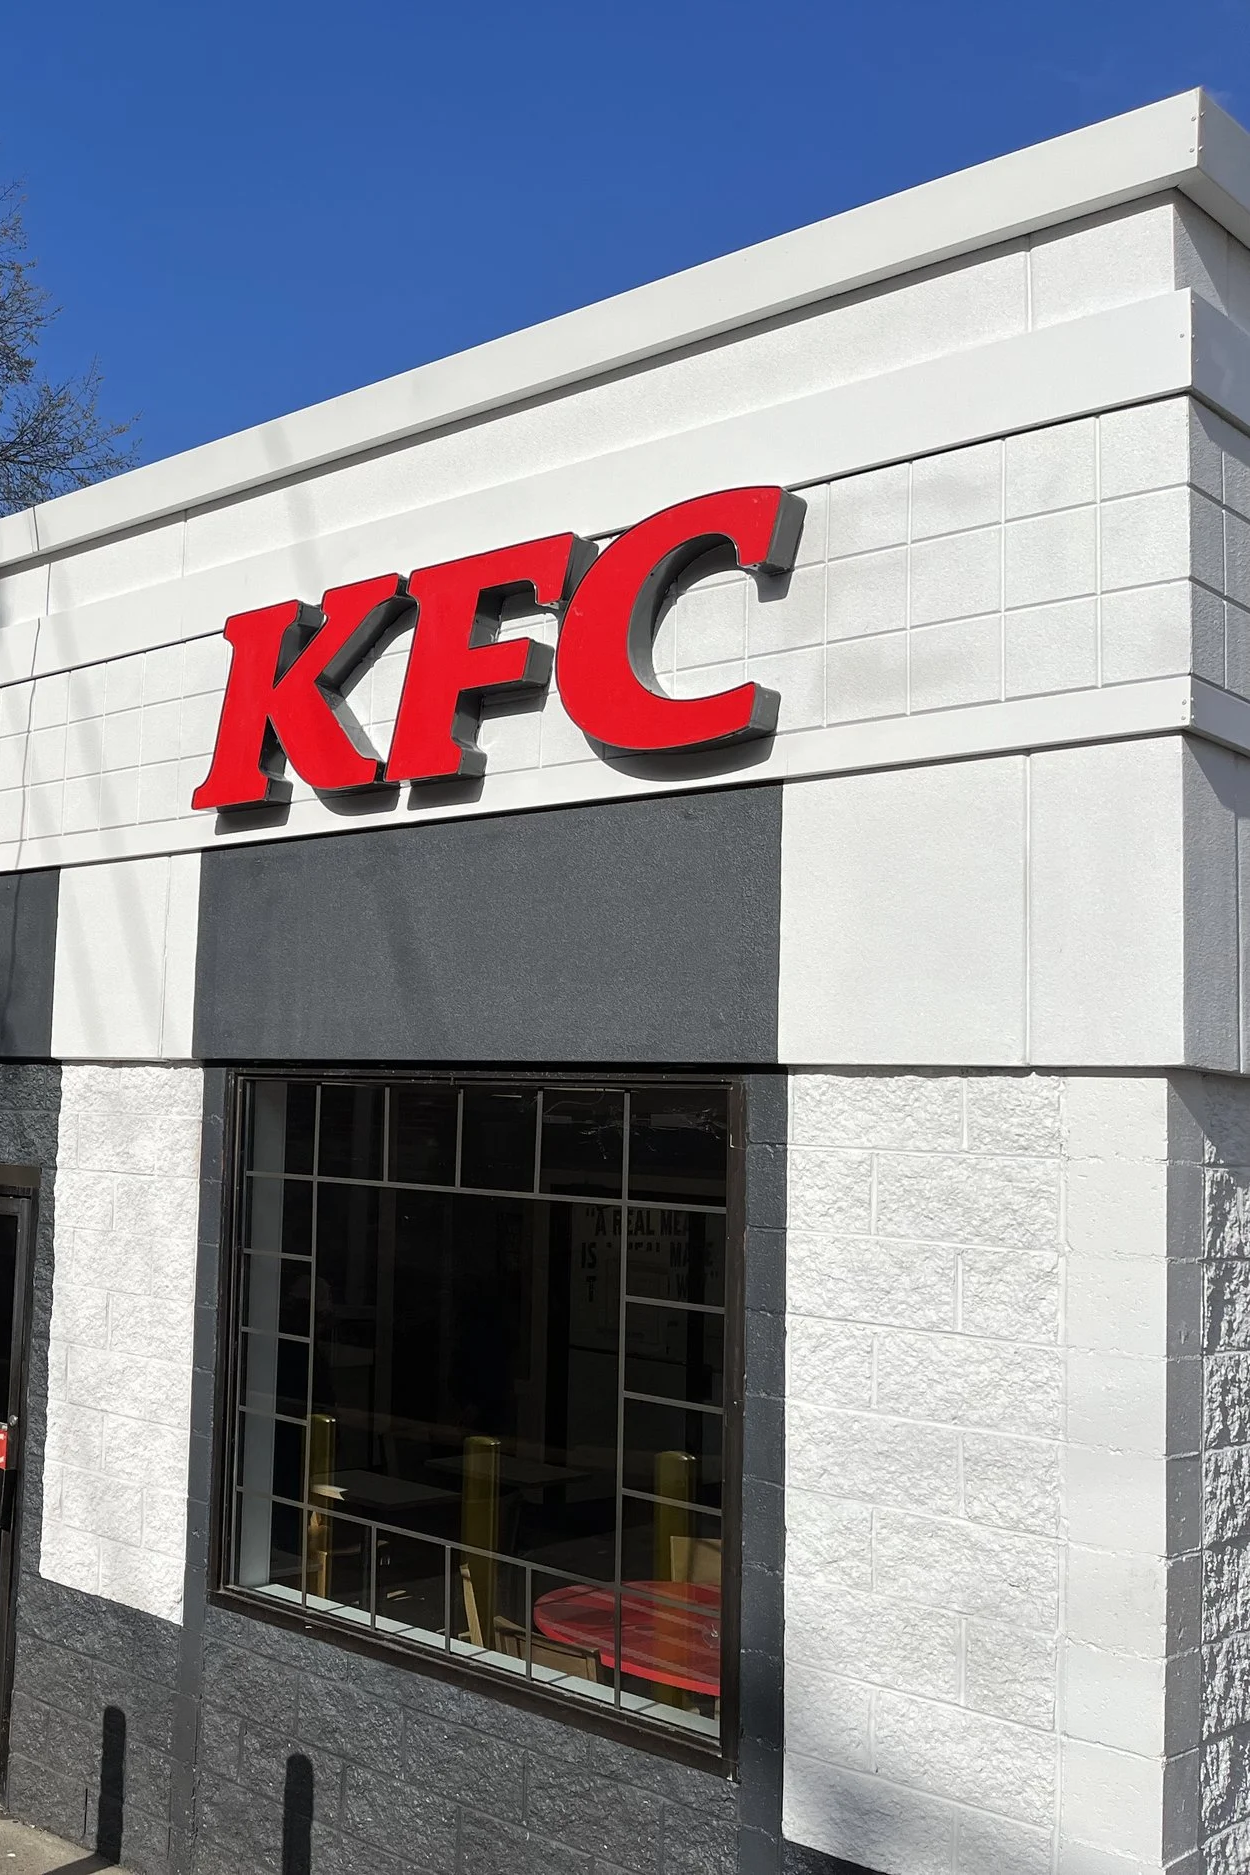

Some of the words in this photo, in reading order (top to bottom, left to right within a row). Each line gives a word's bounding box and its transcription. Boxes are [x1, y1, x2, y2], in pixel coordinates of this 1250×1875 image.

[192, 486, 795, 811] KFC
[613, 1210, 655, 1236] REAL
[581, 1242, 596, 1268] IS
